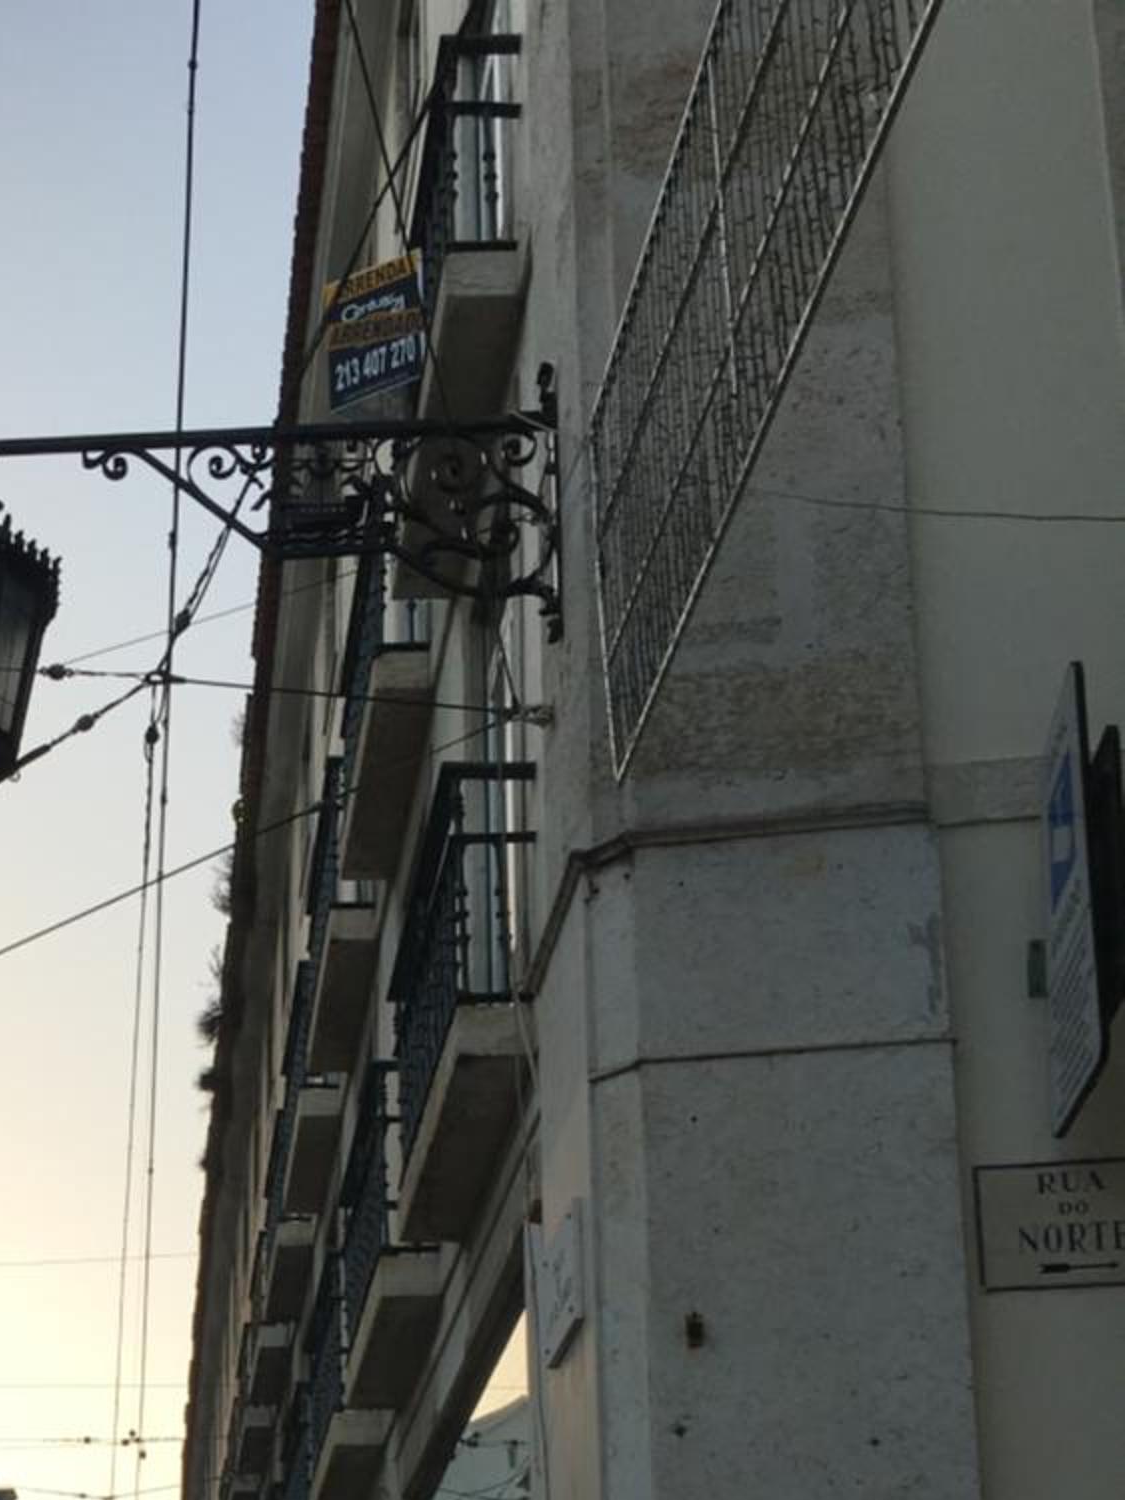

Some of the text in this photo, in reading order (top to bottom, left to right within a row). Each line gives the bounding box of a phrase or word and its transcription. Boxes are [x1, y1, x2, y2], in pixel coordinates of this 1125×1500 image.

[335, 357, 360, 391] 213
[363, 346, 387, 379] 407
[1037, 1169, 1106, 1195] RUA
[1059, 1201, 1090, 1215] DO
